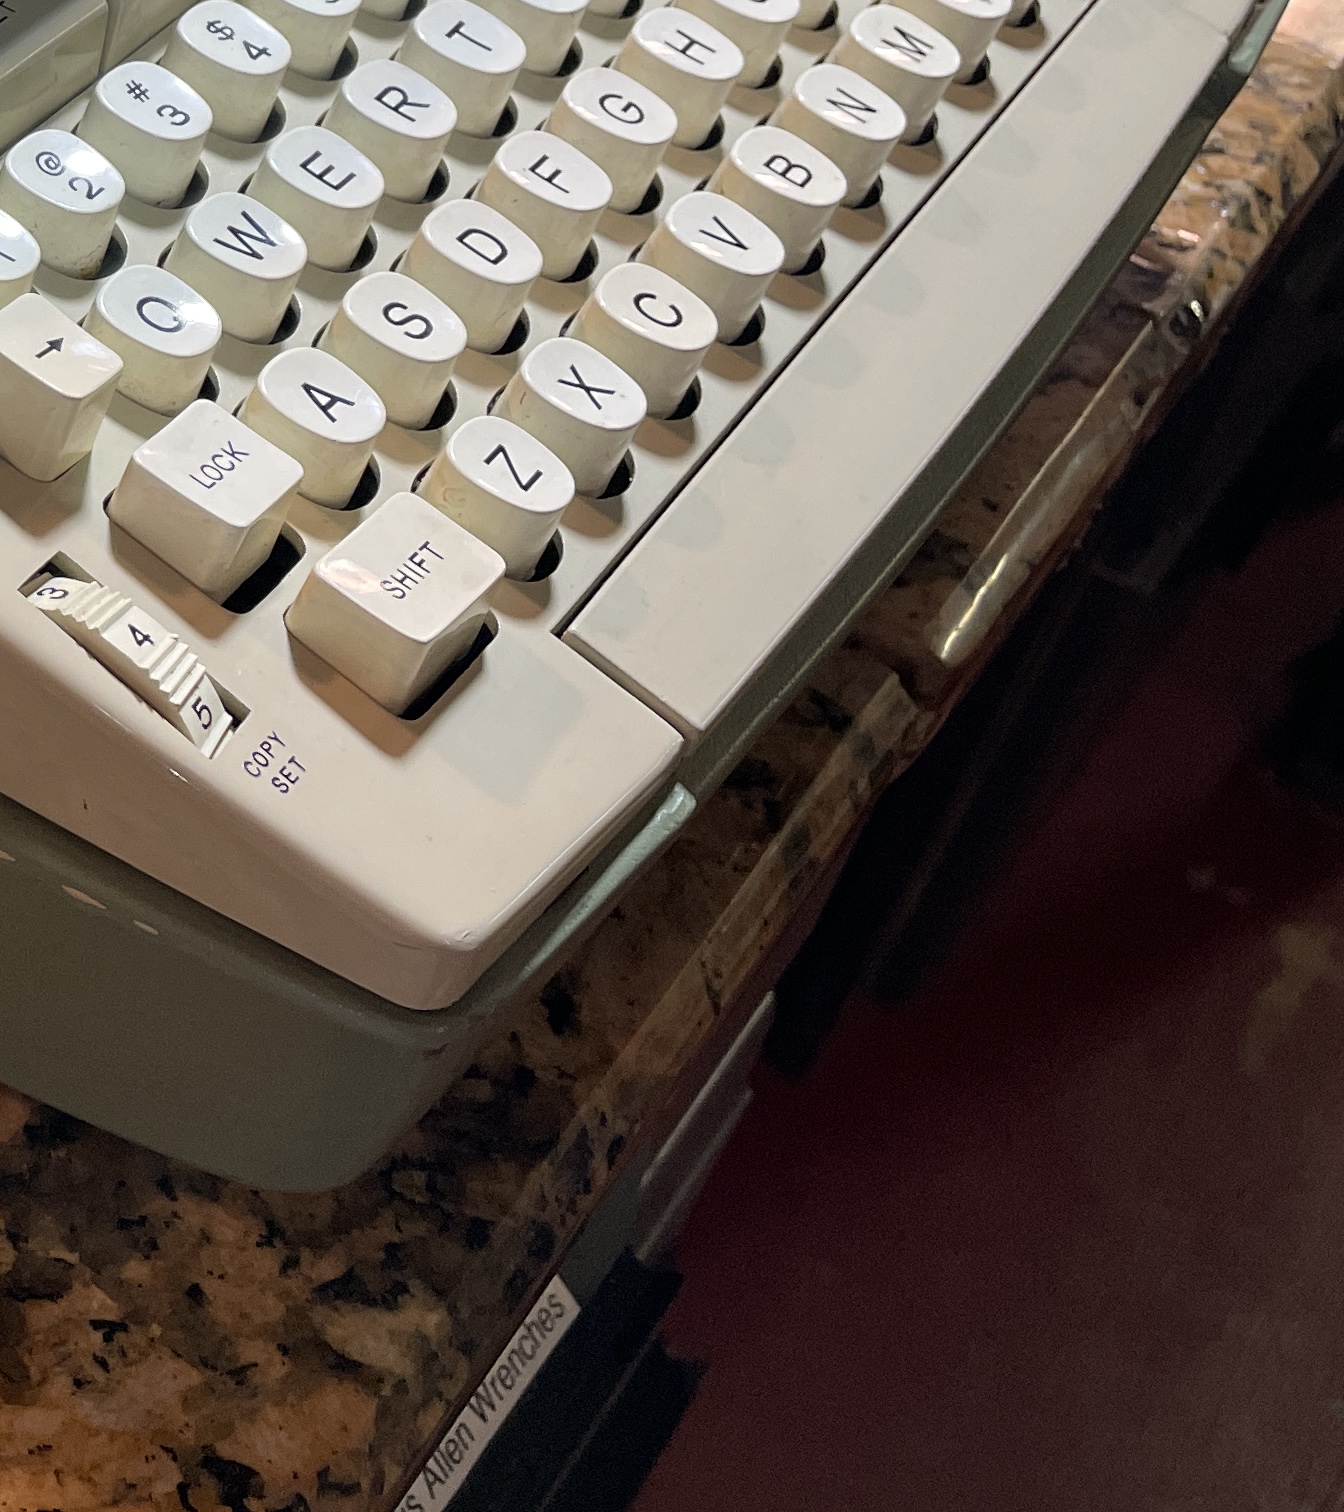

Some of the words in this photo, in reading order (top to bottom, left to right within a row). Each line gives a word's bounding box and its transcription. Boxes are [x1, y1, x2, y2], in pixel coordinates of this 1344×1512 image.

[206, 18, 235, 42] $
[444, 20, 494, 53] T
[662, 29, 718, 67] H
[879, 24, 935, 64] M
[242, 39, 273, 61] 4
[125, 79, 151, 104] #
[373, 84, 432, 124] R
[597, 92, 645, 125] G
[826, 86, 879, 125] N
[156, 103, 191, 127] 3
[35, 150, 66, 177] @
[298, 149, 358, 192] E
[527, 153, 571, 195] F
[762, 154, 814, 189] B
[68, 175, 106, 200] 2
[212, 209, 279, 261] W
[454, 227, 509, 266] D
[697, 215, 751, 251] V
[381, 301, 435, 341] S
[632, 292, 684, 328] C
[300, 381, 356, 424] A
[555, 363, 617, 411] X
[188, 440, 250, 490] LOCK
[482, 443, 544, 493] Z
[379, 540, 446, 601] SHIFT
[36, 585, 70, 601] 3
[127, 622, 156, 649] 4
[190, 695, 214, 730] 5
[242, 729, 287, 779] COPY
[270, 754, 308, 795] SET
[422, 1423, 478, 1501] Allen
[468, 1291, 566, 1424] Wrenches
